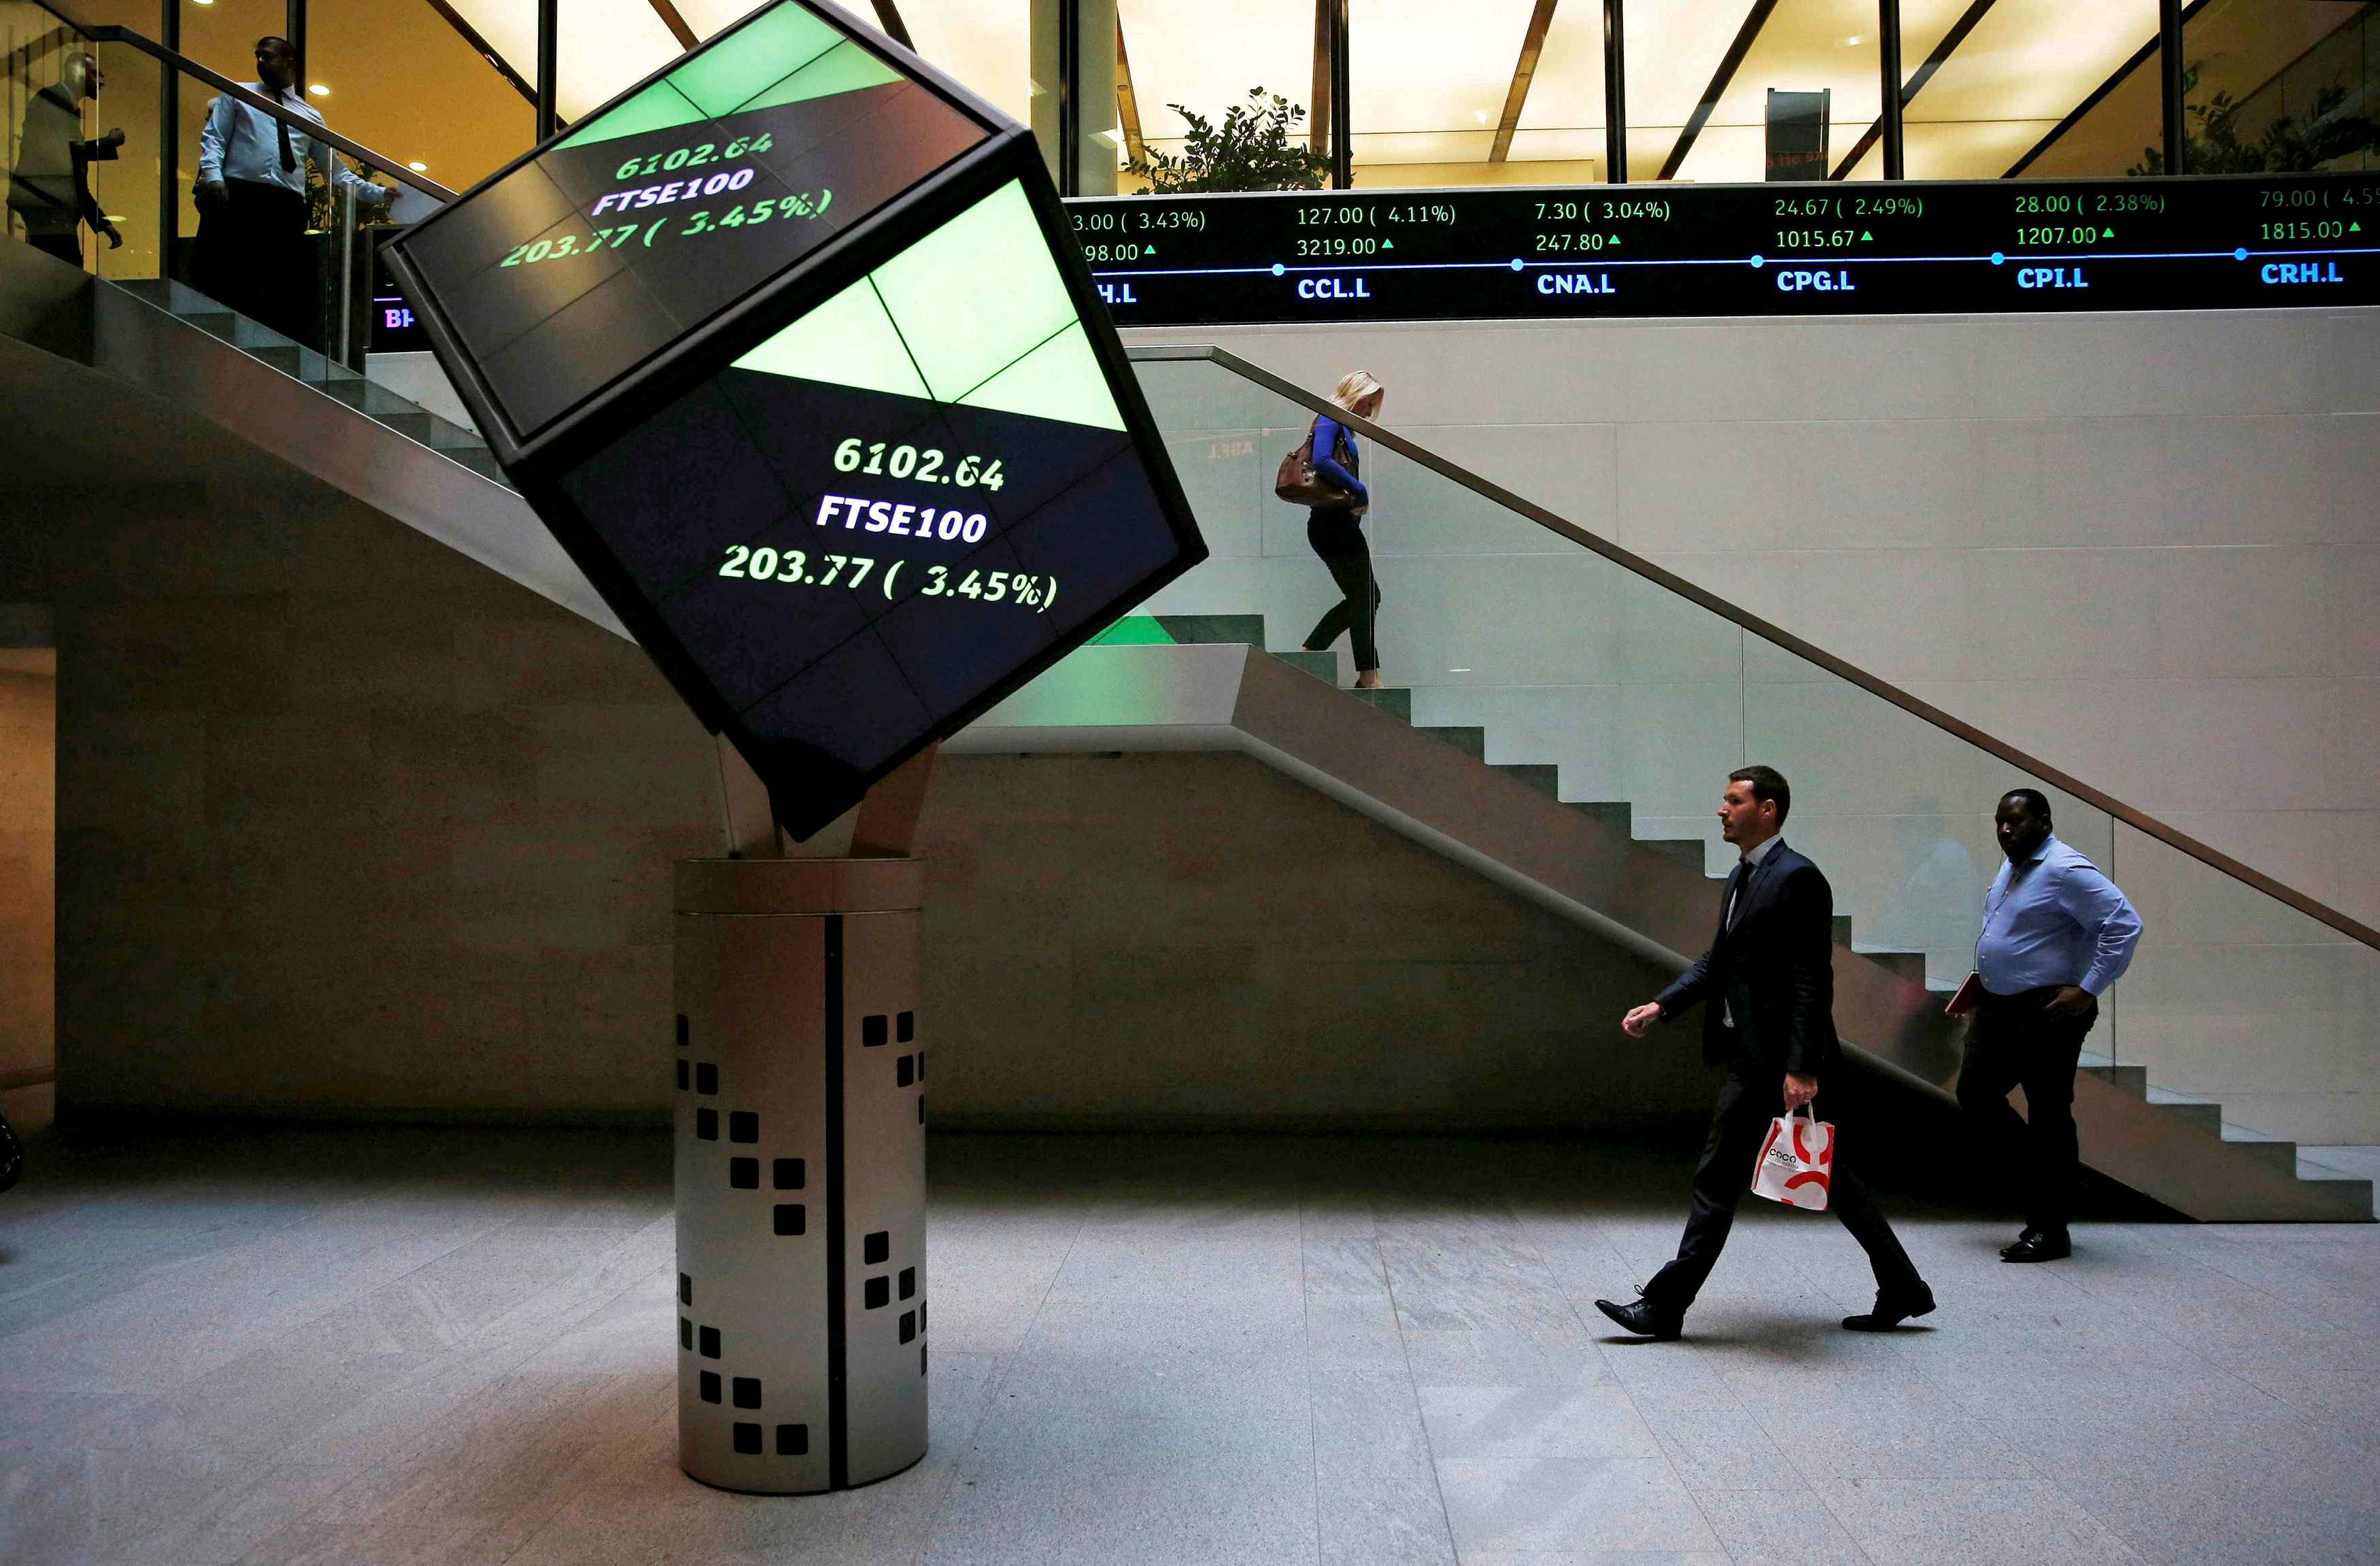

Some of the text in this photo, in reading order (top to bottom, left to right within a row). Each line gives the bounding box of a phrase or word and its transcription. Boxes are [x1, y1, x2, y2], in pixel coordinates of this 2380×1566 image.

[615, 133, 773, 181] 6102.64
[591, 168, 755, 217] FTSE100
[2016, 196, 2070, 213] 28.00
[2096, 193, 2166, 213] 2.38%)
[2260, 190, 2316, 207] 79.00
[1298, 207, 1363, 225] 127.00
[1388, 205, 1455, 226] 4.11%)
[1535, 203, 1577, 220] 7.30
[1603, 201, 1670, 222] 3.04%)
[1775, 199, 1829, 216] 24.67
[1855, 198, 1922, 218] 2.49%)
[1073, 214, 1114, 231] 3.00
[1139, 210, 1205, 231] 3.43%)
[2262, 221, 2343, 239] 1815.00
[500, 223, 641, 269] 203.77
[1536, 233, 1603, 251] 247.80
[1777, 230, 1854, 248] 1015.67
[2017, 226, 2096, 245] 1207.00
[1081, 243, 1138, 262] 98.00
[1297, 238, 1376, 256] 3219.00
[1537, 273, 1616, 294] CNA.L
[1777, 271, 1855, 291] CPG.L
[2017, 267, 2089, 289] CPI.L
[2261, 262, 2343, 284] CRH.L
[1297, 277, 1370, 299] CCL.L
[834, 438, 1004, 492] 6102.64
[815, 494, 987, 543] FTSE100
[718, 545, 874, 588] 203.77
[921, 565, 1057, 613] 3.45%)
